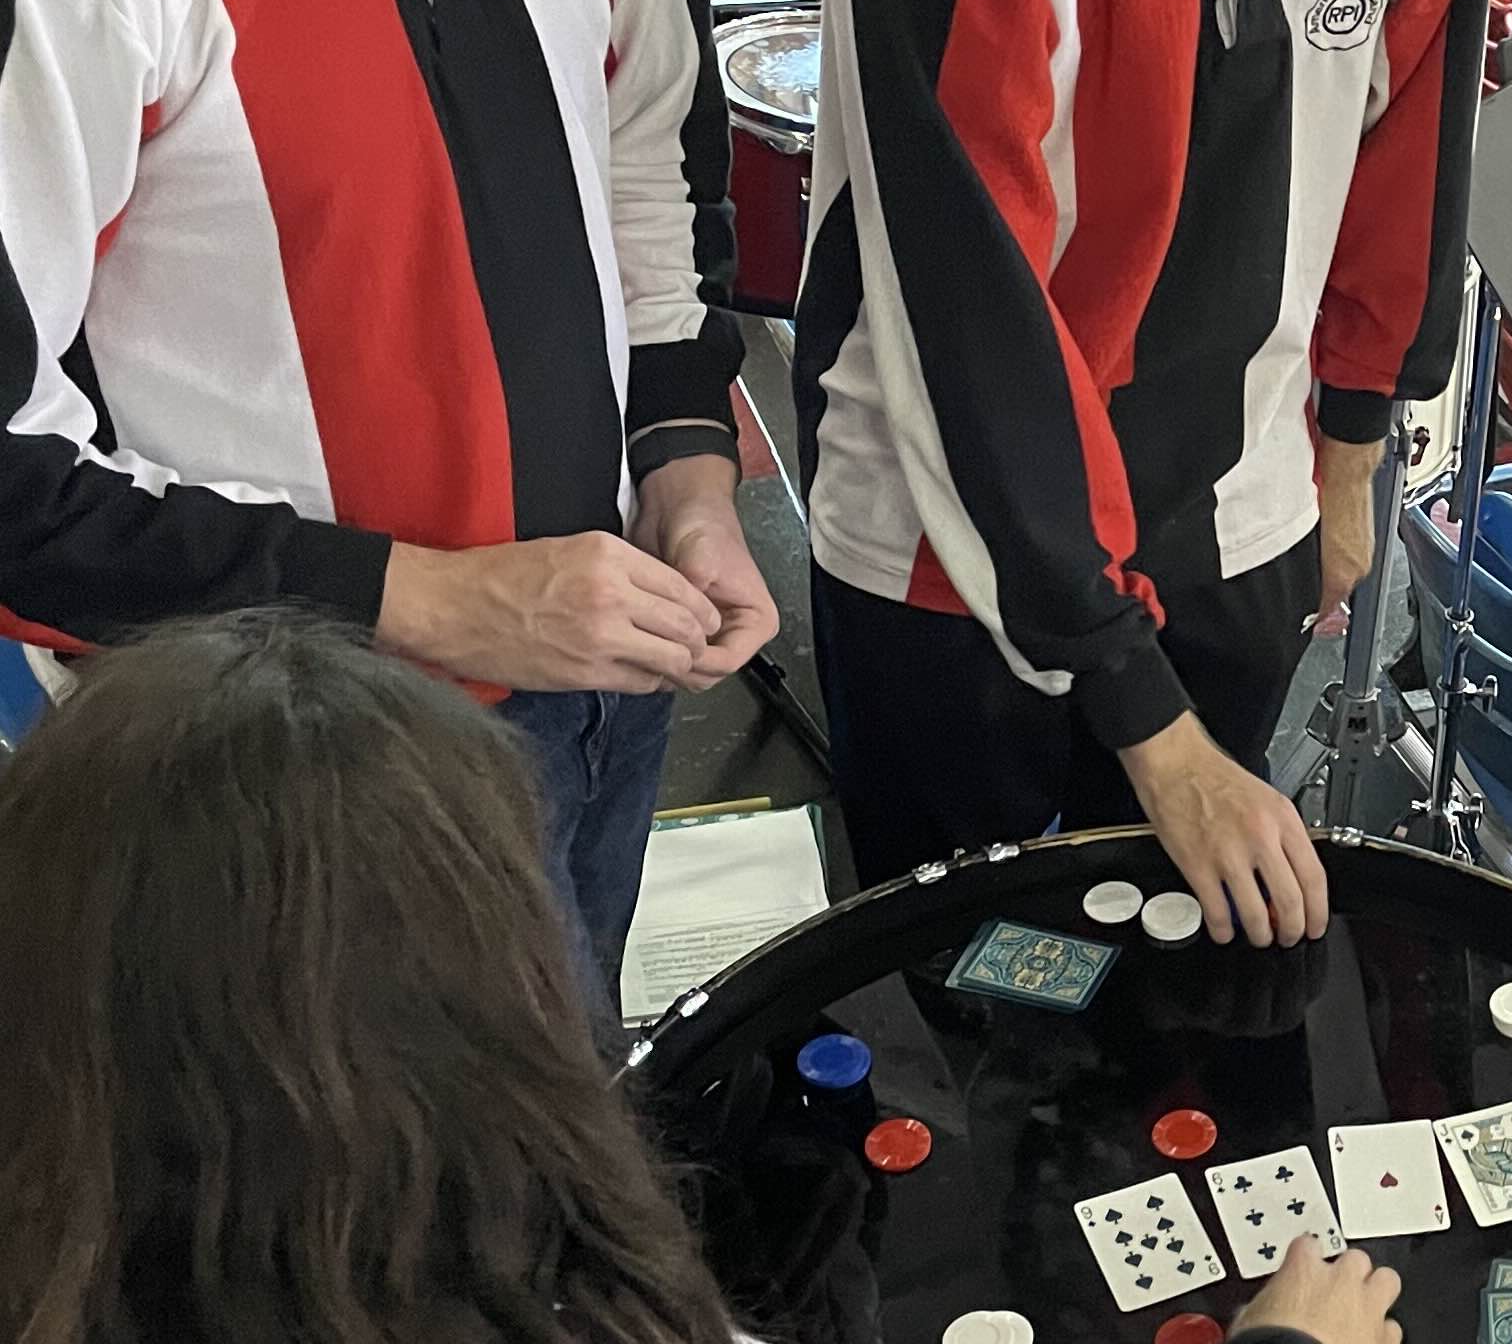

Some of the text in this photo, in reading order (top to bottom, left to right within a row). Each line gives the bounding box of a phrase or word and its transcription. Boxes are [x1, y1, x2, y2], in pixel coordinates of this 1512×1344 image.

[1327, 3, 1360, 24] RPI
[1333, 1132, 1345, 1146] A
[1211, 1171, 1224, 1186] 6
[1080, 1205, 1094, 1220] 9
